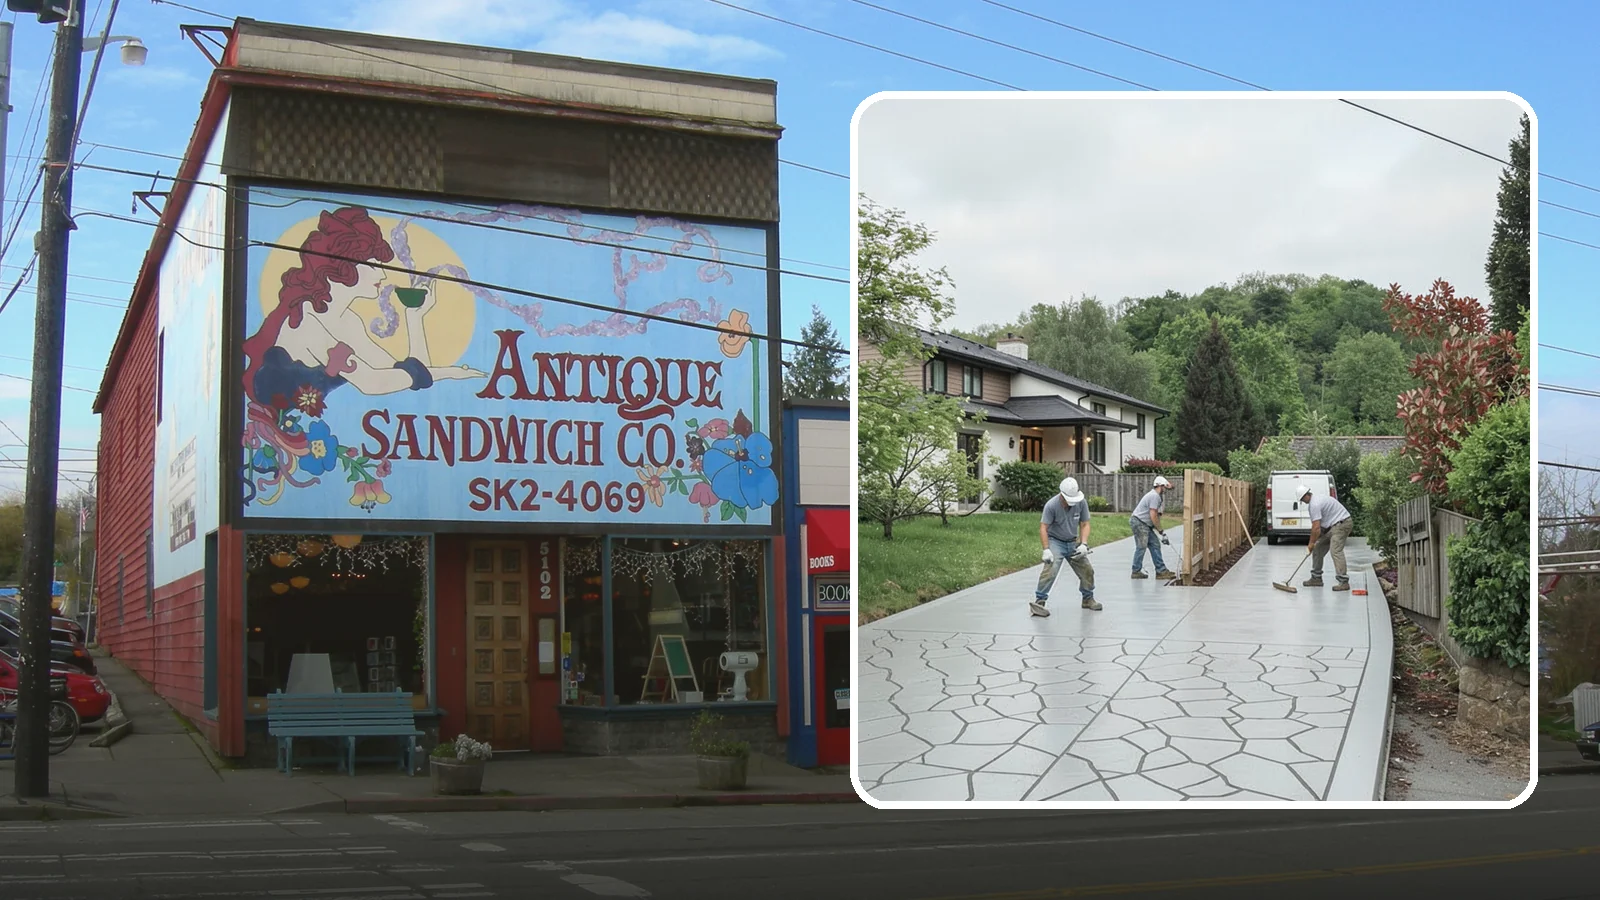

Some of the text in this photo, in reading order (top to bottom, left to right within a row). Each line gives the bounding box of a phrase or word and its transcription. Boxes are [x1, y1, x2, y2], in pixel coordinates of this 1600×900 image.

[469, 477, 646, 513] SK2-4069
[540, 542, 551, 599] 5102
[809, 555, 834, 569] BOOKS
